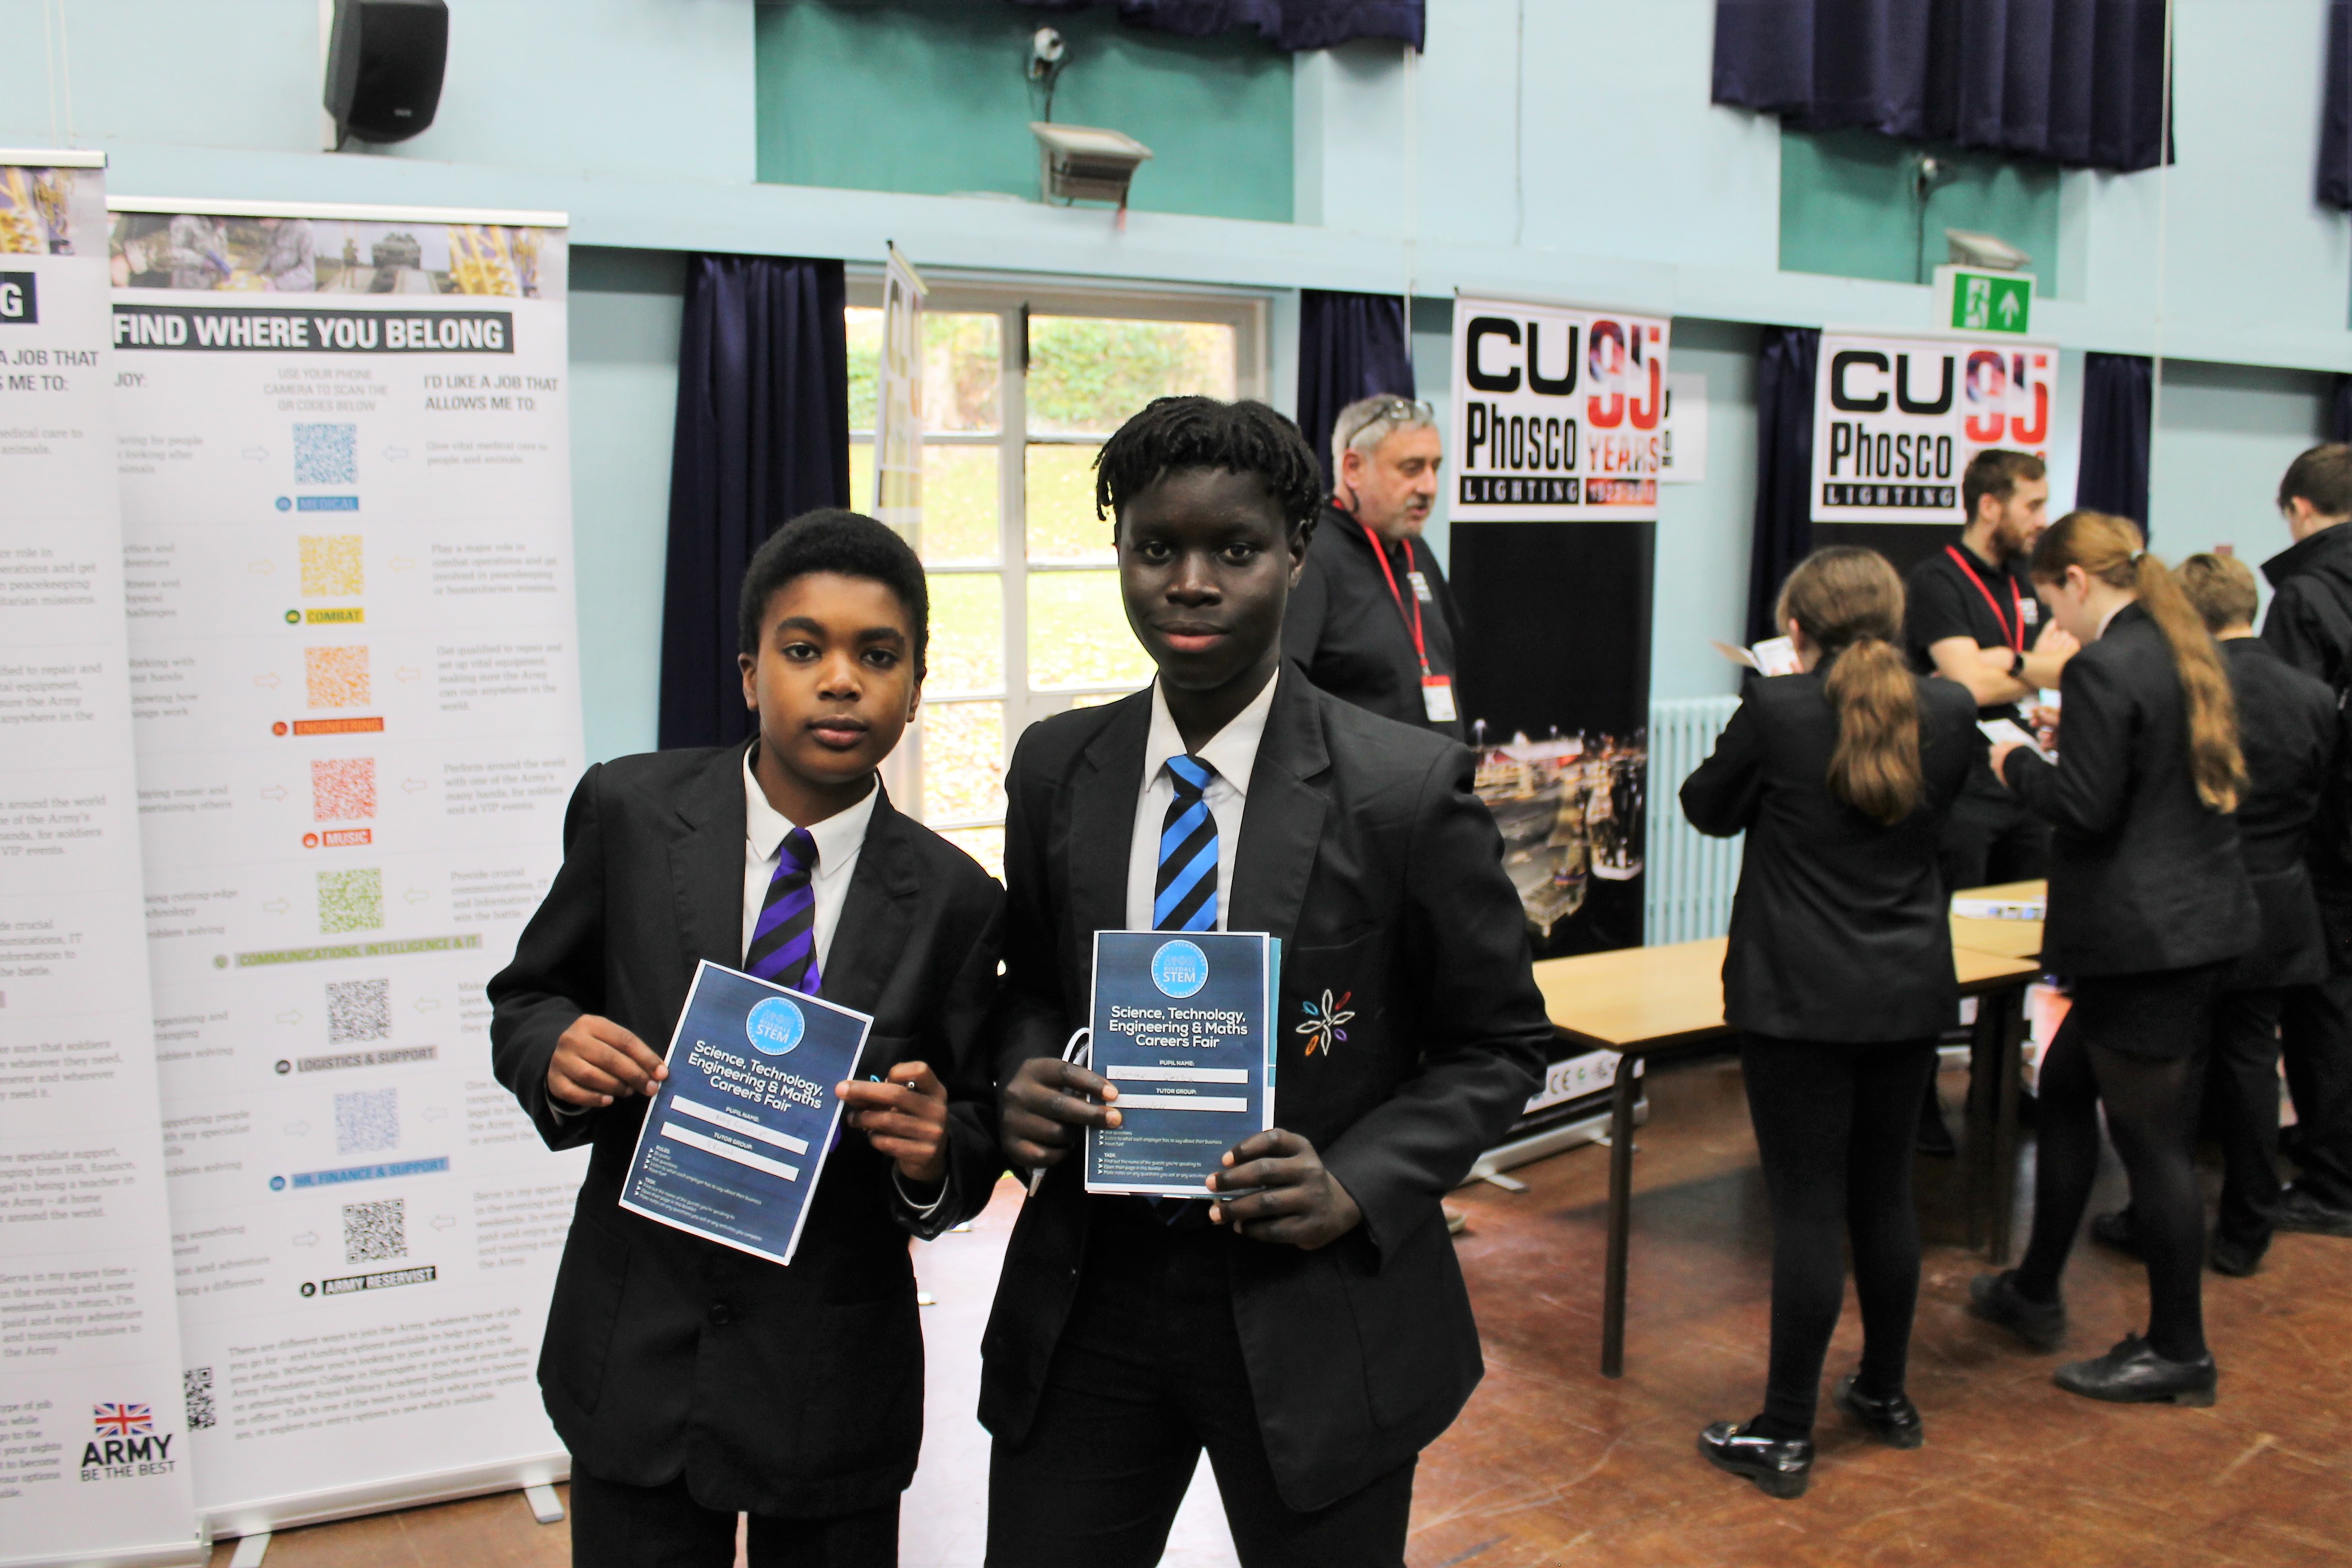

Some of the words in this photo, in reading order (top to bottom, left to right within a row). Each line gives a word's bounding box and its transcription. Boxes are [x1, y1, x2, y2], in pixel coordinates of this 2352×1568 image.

[113, 314, 188, 346] FIND
[193, 315, 309, 347] WHERE
[314, 317, 378, 349] YOU
[385, 318, 504, 350] BELONG
[13, 350, 48, 366] JOB
[53, 350, 99, 367] THAT
[1467, 317, 1578, 396] CU
[9, 375, 36, 391] ME
[424, 375, 442, 389] I'D
[446, 375, 476, 389] LIKE
[480, 375, 491, 389] A
[494, 375, 521, 389] JOB
[525, 377, 558, 391] THAT
[1831, 350, 1954, 416] CU
[424, 396, 487, 411] ALLOWS
[491, 396, 513, 411] ME
[516, 398, 538, 412] TO:
[1466, 402, 1576, 472] Phosco
[1588, 435, 1658, 472] YEARS
[1830, 422, 1952, 479] Phosco
[1465, 480, 1578, 502] LIGHTING
[1827, 484, 1953, 507] LIGHTING
[307, 610, 361, 623] COMBAT
[327, 831, 368, 845] MUSIC
[366, 938, 450, 955] INTELLIGENCE
[453, 937, 463, 948] &
[466, 936, 477, 948] IT
[1163, 972, 1196, 983] STEM
[1111, 1005, 1165, 1020] Science,
[1168, 1007, 1246, 1023] Technology,
[755, 1025, 790, 1044] STEM
[1109, 1020, 1189, 1037] Engineering
[1192, 1021, 1202, 1034] &
[1205, 1022, 1248, 1035] Maths
[1136, 1034, 1190, 1047] Careers
[1193, 1036, 1220, 1048] Fair
[298, 1055, 361, 1072] LOGISTICS
[365, 1054, 374, 1066] &
[378, 1047, 434, 1064] SUPPORT
[694, 1039, 747, 1070] Science,
[751, 1059, 823, 1097] Technology,
[688, 1052, 766, 1093] Engineering
[767, 1080, 779, 1094] &
[780, 1085, 822, 1110] Maths
[710, 1076, 762, 1103] Careers
[764, 1094, 792, 1112] Fair
[726, 1107, 743, 1118] PUPIL
[714, 1132, 733, 1144] TUTOR
[318, 1167, 372, 1184] FINANCE
[376, 1167, 385, 1177] &
[389, 1159, 445, 1175] SUPPORT
[324, 1277, 364, 1294] ARMY
[367, 1268, 433, 1289] RESERVIST
[82, 1434, 172, 1468] ARMY
[81, 1469, 101, 1482] BE
[105, 1465, 135, 1479] THE
[139, 1460, 176, 1477] BEST
